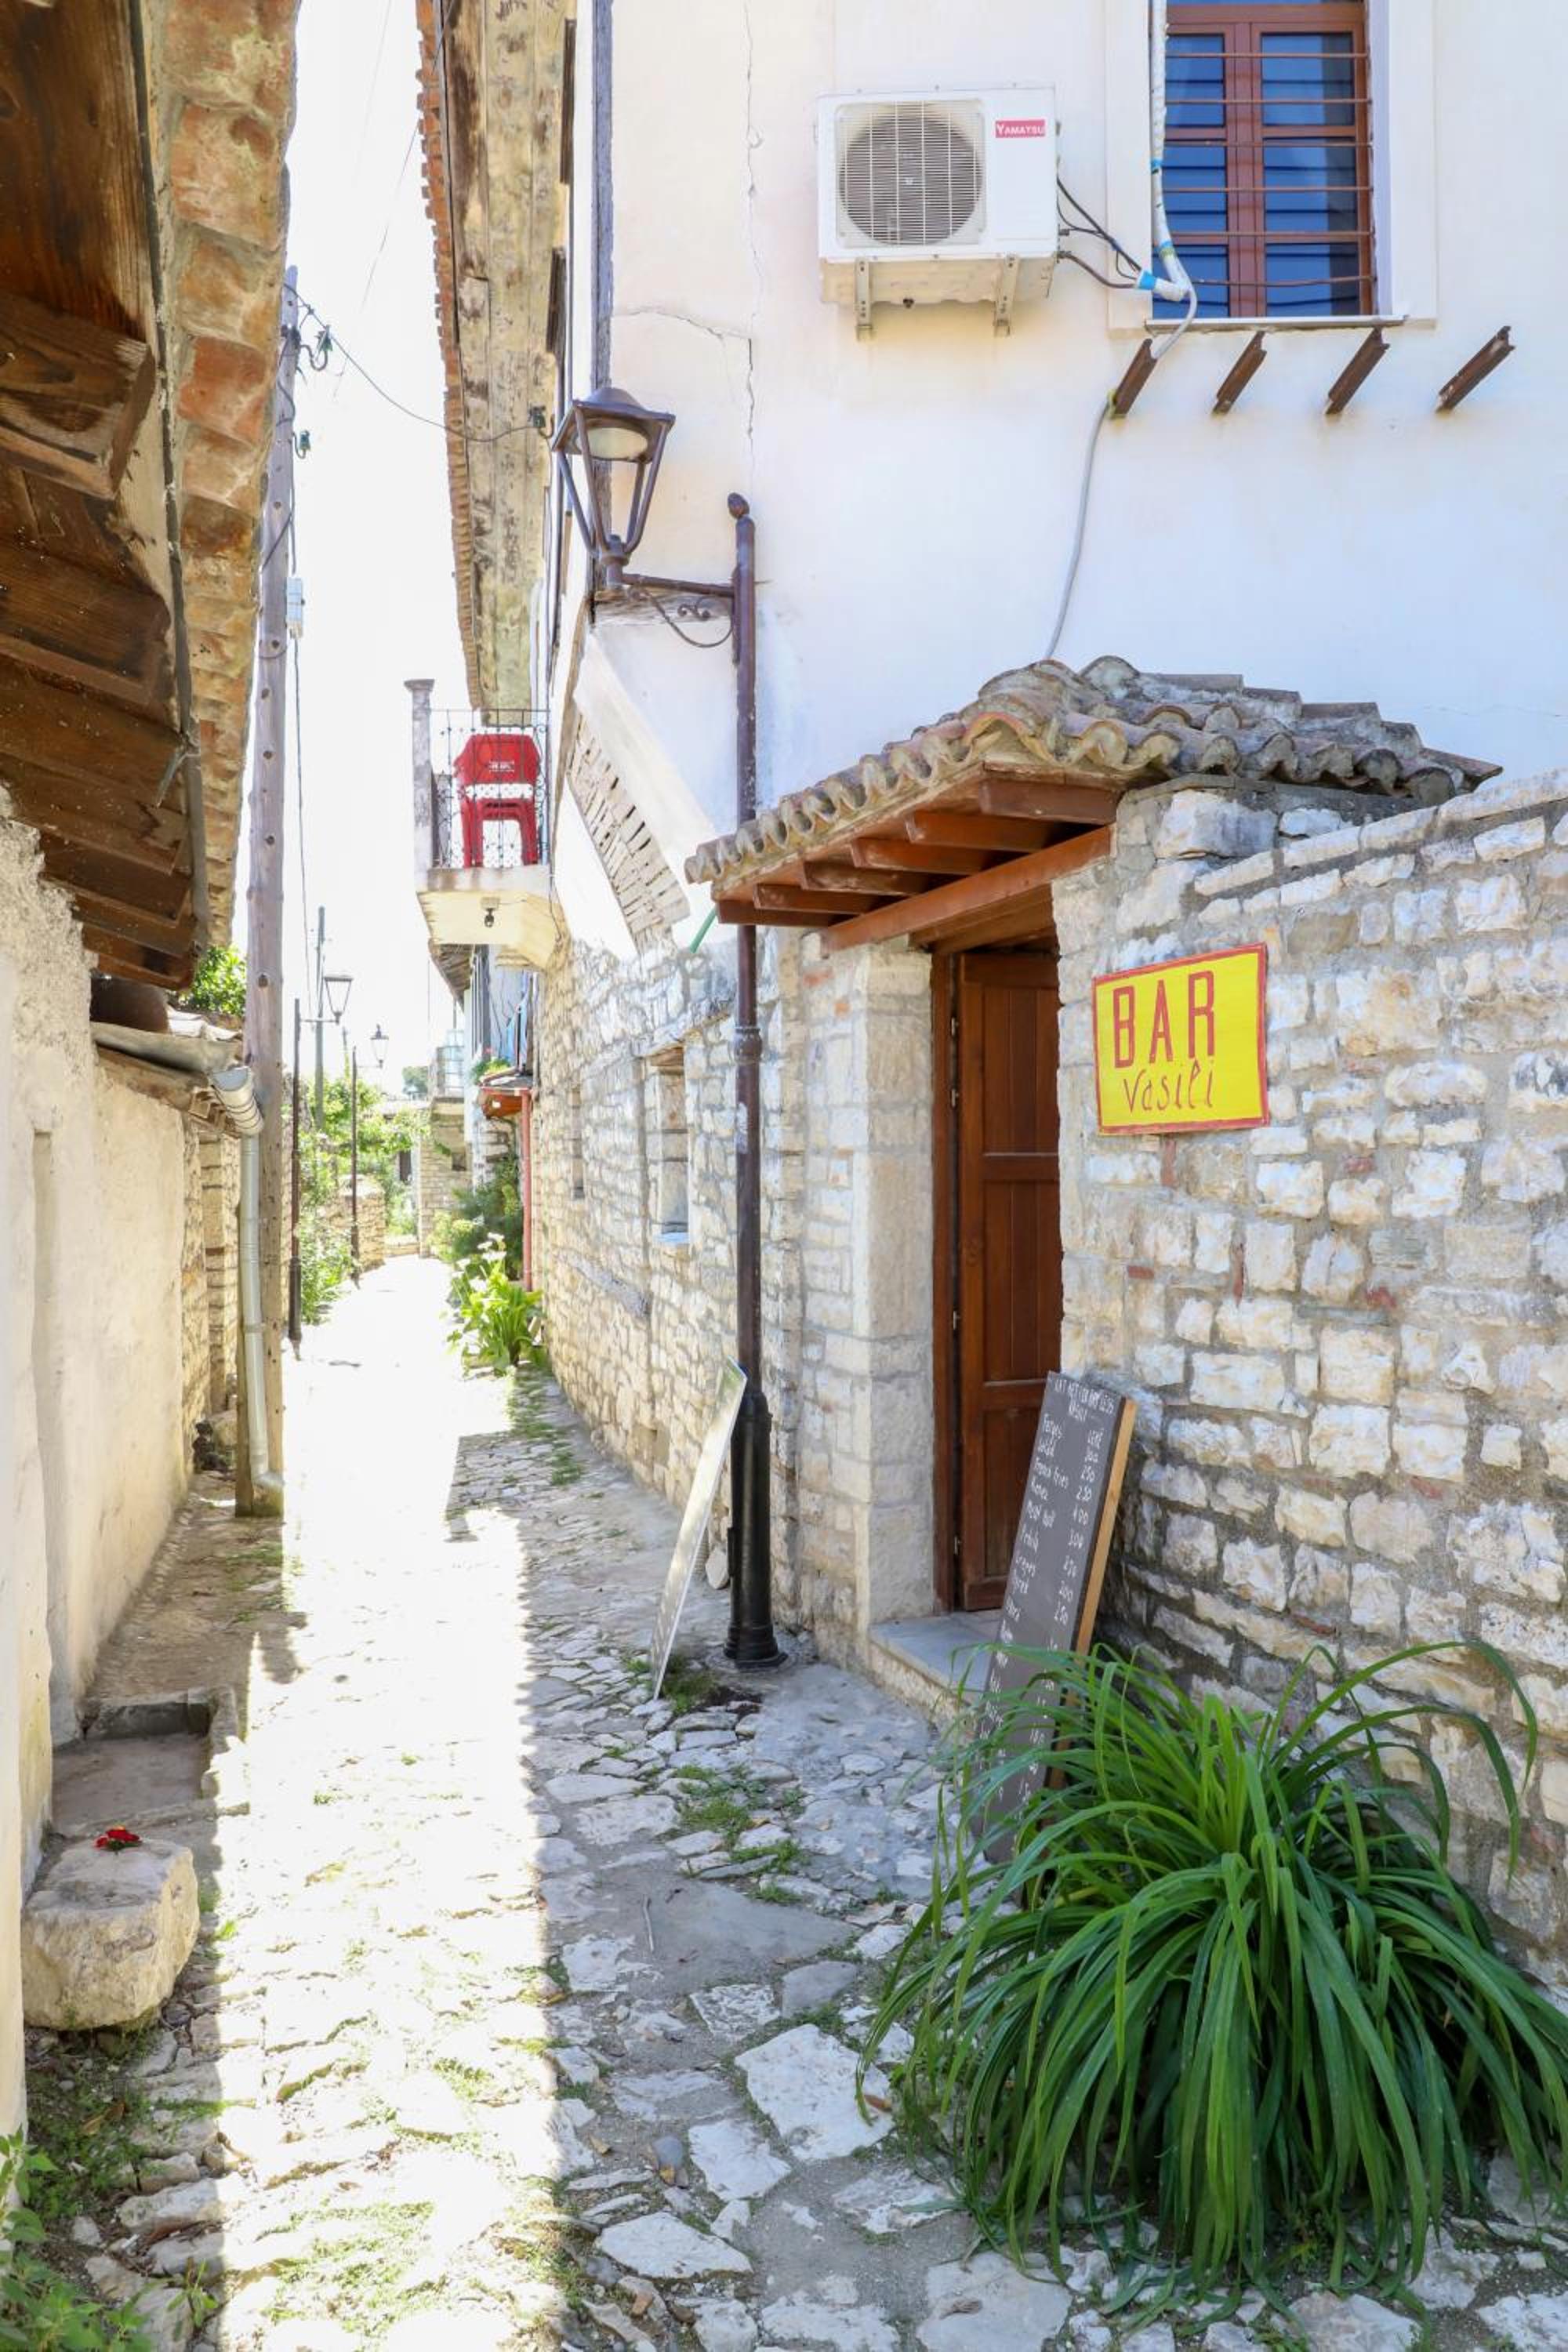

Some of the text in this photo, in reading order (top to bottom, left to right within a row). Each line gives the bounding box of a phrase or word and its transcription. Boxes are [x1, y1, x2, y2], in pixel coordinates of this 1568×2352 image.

[996, 123, 1044, 137] YAMATSU
[1112, 970, 1215, 1068] BAR
[1123, 1059, 1214, 1113] Vasili
